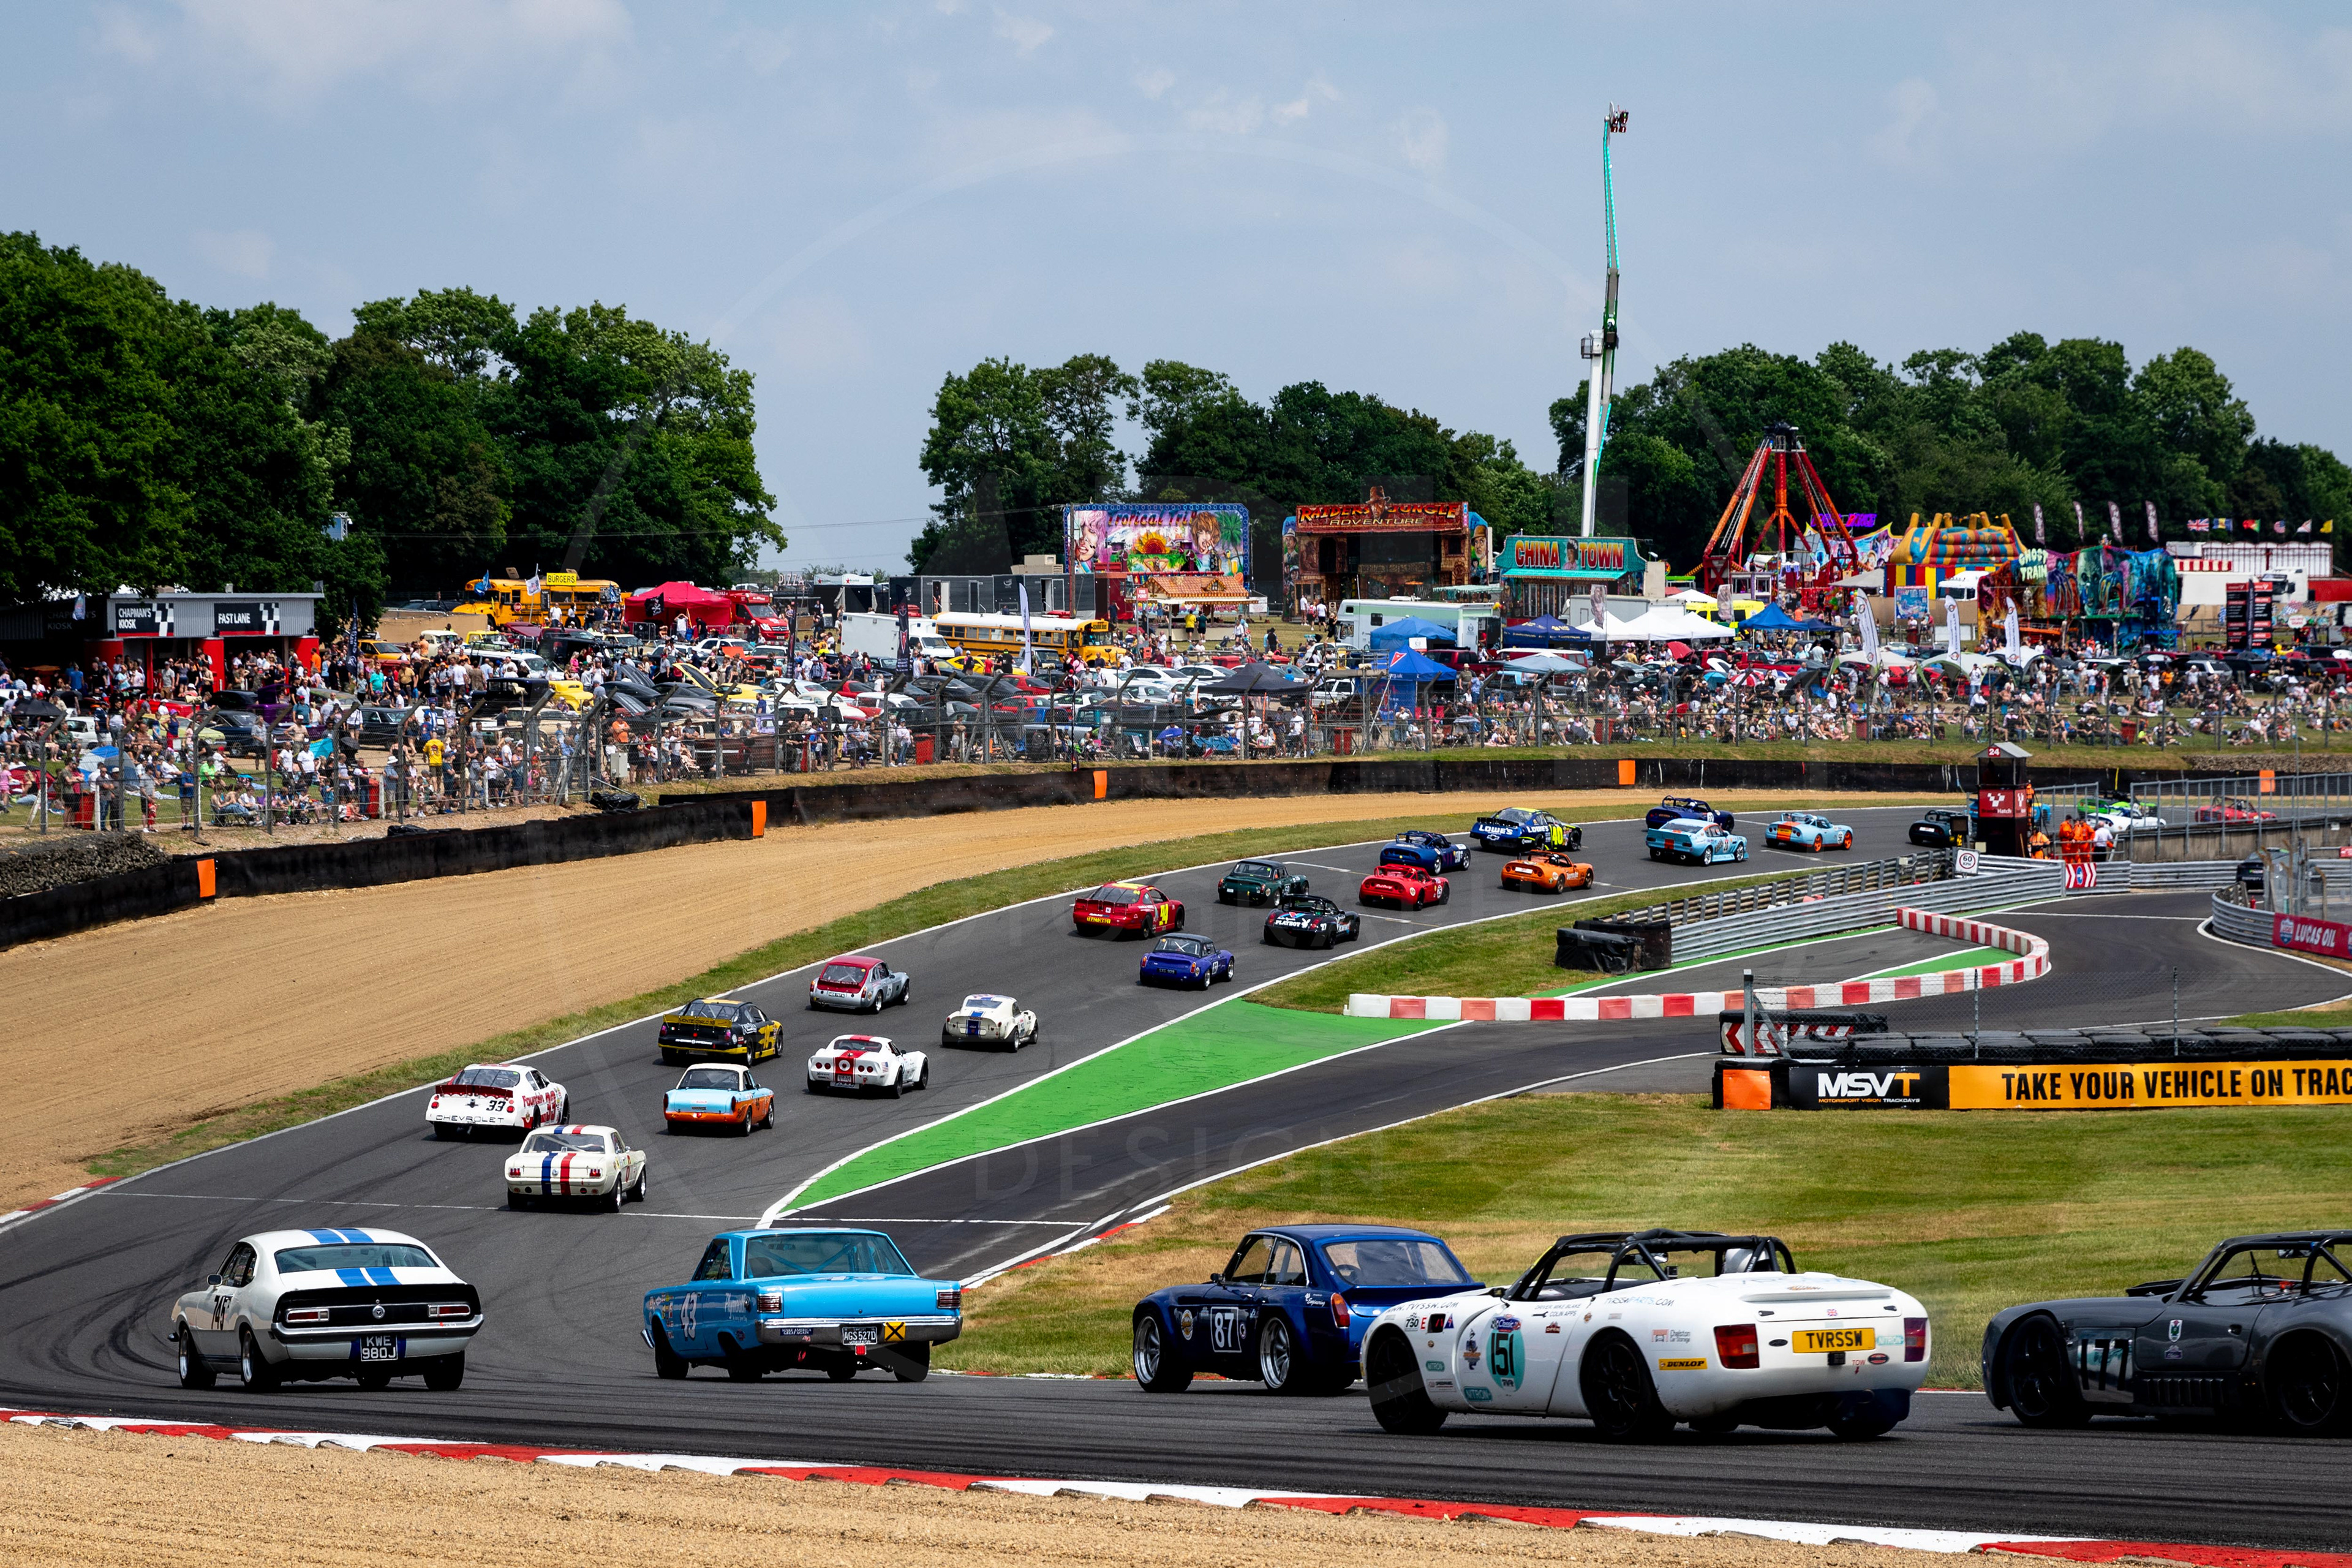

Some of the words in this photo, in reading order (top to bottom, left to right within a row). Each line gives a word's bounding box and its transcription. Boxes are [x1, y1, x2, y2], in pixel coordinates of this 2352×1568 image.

[1299, 506, 1370, 522] RAIDERS
[1387, 505, 1459, 519] JUNGLE
[1515, 540, 1560, 567] CHINA
[1578, 541, 1624, 569] TOWN
[2019, 564, 2048, 581] TRAIN
[548, 575, 576, 584] BURGERS
[778, 574, 805, 586] PIZZA
[118, 608, 152, 618] CHAPMAN'S
[218, 614, 234, 624] FAST
[234, 613, 251, 624] LANE
[118, 619, 137, 629] KIOSK
[1479, 824, 1513, 835] LOWE'S
[1526, 825, 1550, 834] LOWE'S
[2294, 924, 2323, 945] LUCAS
[2321, 928, 2337, 948] OIL
[1818, 1072, 1921, 1097] MSVT
[2001, 1072, 2062, 1101] TAKE
[2070, 1071, 2135, 1100] YOUR
[2144, 1070, 2242, 1099] VEHICLE
[2251, 1069, 2283, 1098] ON
[486, 1099, 506, 1112] 33
[680, 1292, 696, 1341] 43
[1420, 1317, 1427, 1329] E
[844, 1332, 858, 1340] AGS
[858, 1332, 876, 1341] 527D
[1215, 1312, 1234, 1348] 87
[366, 1335, 391, 1346] KWE
[1806, 1330, 1863, 1349] TVRSSW
[362, 1347, 396, 1359] 980J
[1491, 1333, 1515, 1376] 151
[2081, 1339, 2130, 1390] 177
